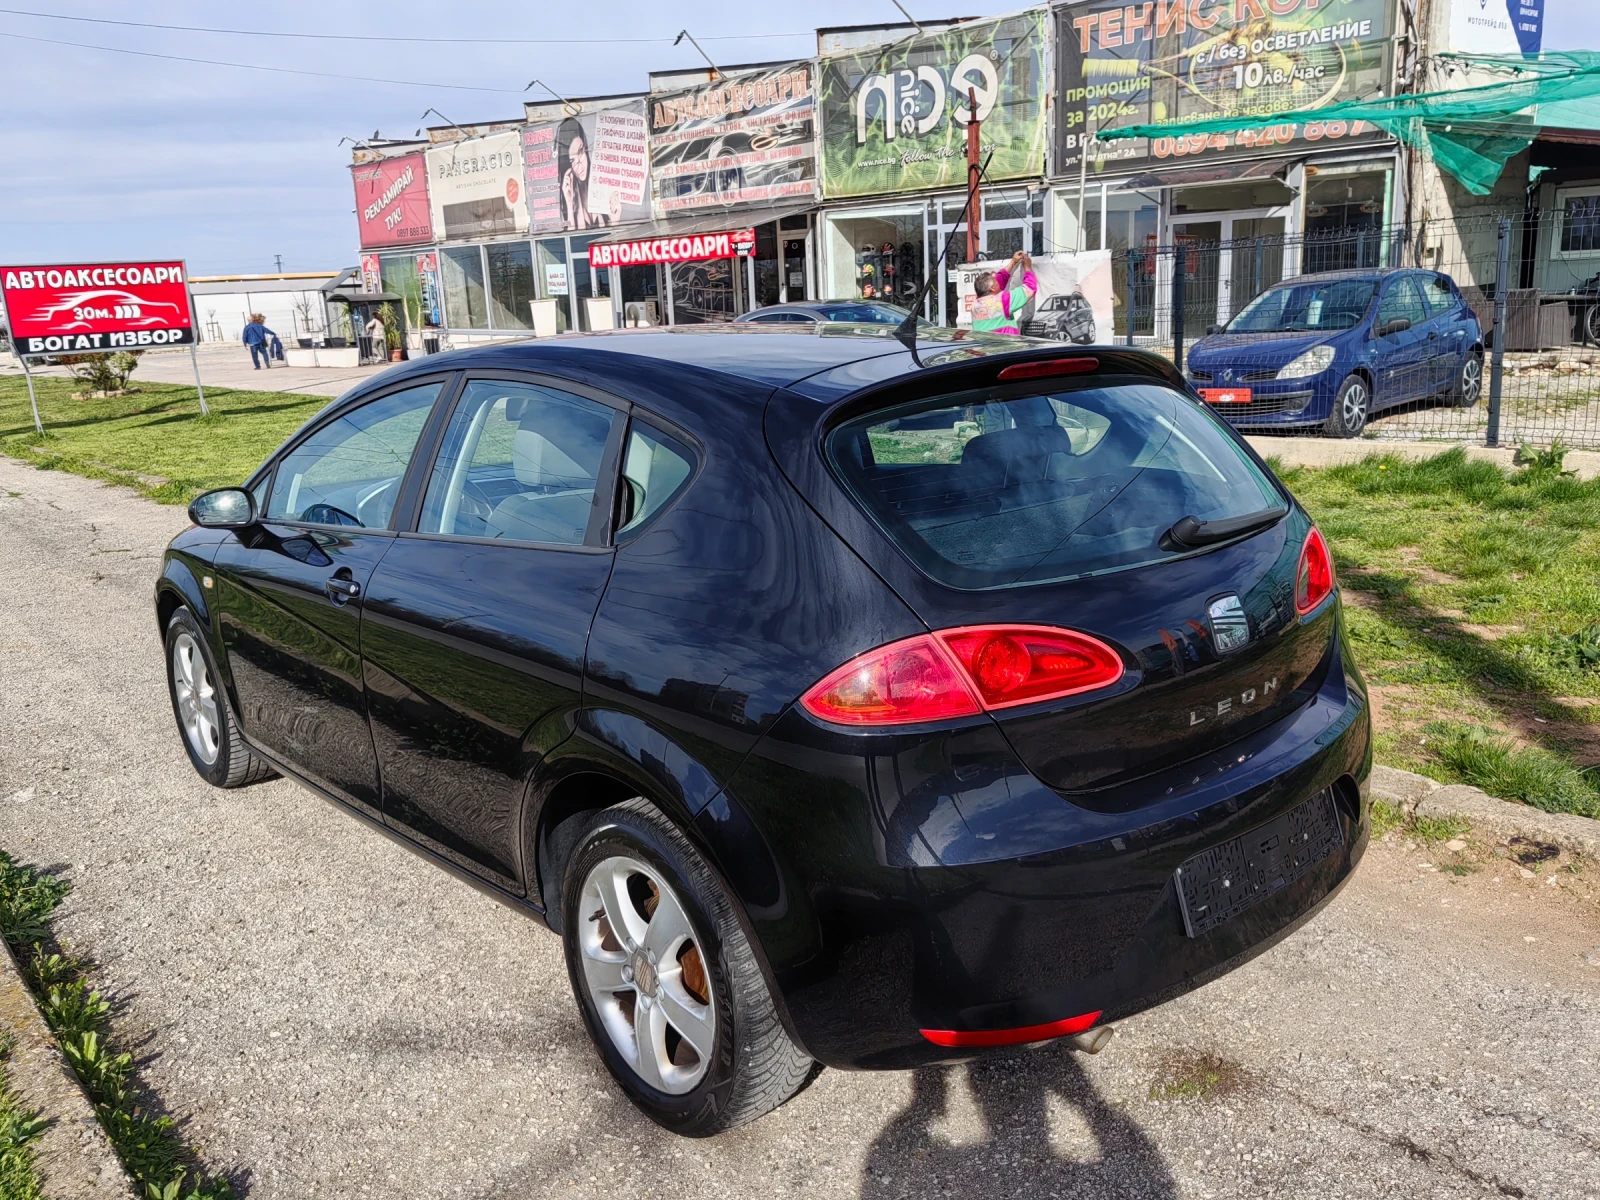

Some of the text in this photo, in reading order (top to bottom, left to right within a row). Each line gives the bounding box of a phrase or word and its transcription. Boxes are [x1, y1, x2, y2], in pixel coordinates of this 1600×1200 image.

[1073, 0, 1219, 53] ТЕНИС
[1251, 20, 1371, 54] ОСВЕТЛЕНИЕ
[653, 70, 808, 129] АВТОАКСЕСОАРИ
[1066, 76, 1151, 103] ПРОМОЦИЯ
[1066, 110, 1084, 128] за
[438, 151, 513, 179] PANCRACIO
[857, 157, 896, 168] www.nice.bg
[364, 164, 414, 223] РЕКЛАМИРАЙ
[473, 177, 497, 187] CHOCOLATE
[384, 206, 403, 231] ТУК!
[592, 234, 729, 265] АВТОАКСЕСОАРИ
[5, 266, 183, 290] АВТОАКСЕСОАРИ
[73, 306, 113, 321] 30м.
[28, 329, 183, 352] БОГАТ ИЗБОР
[1189, 677, 1278, 727] LEON
